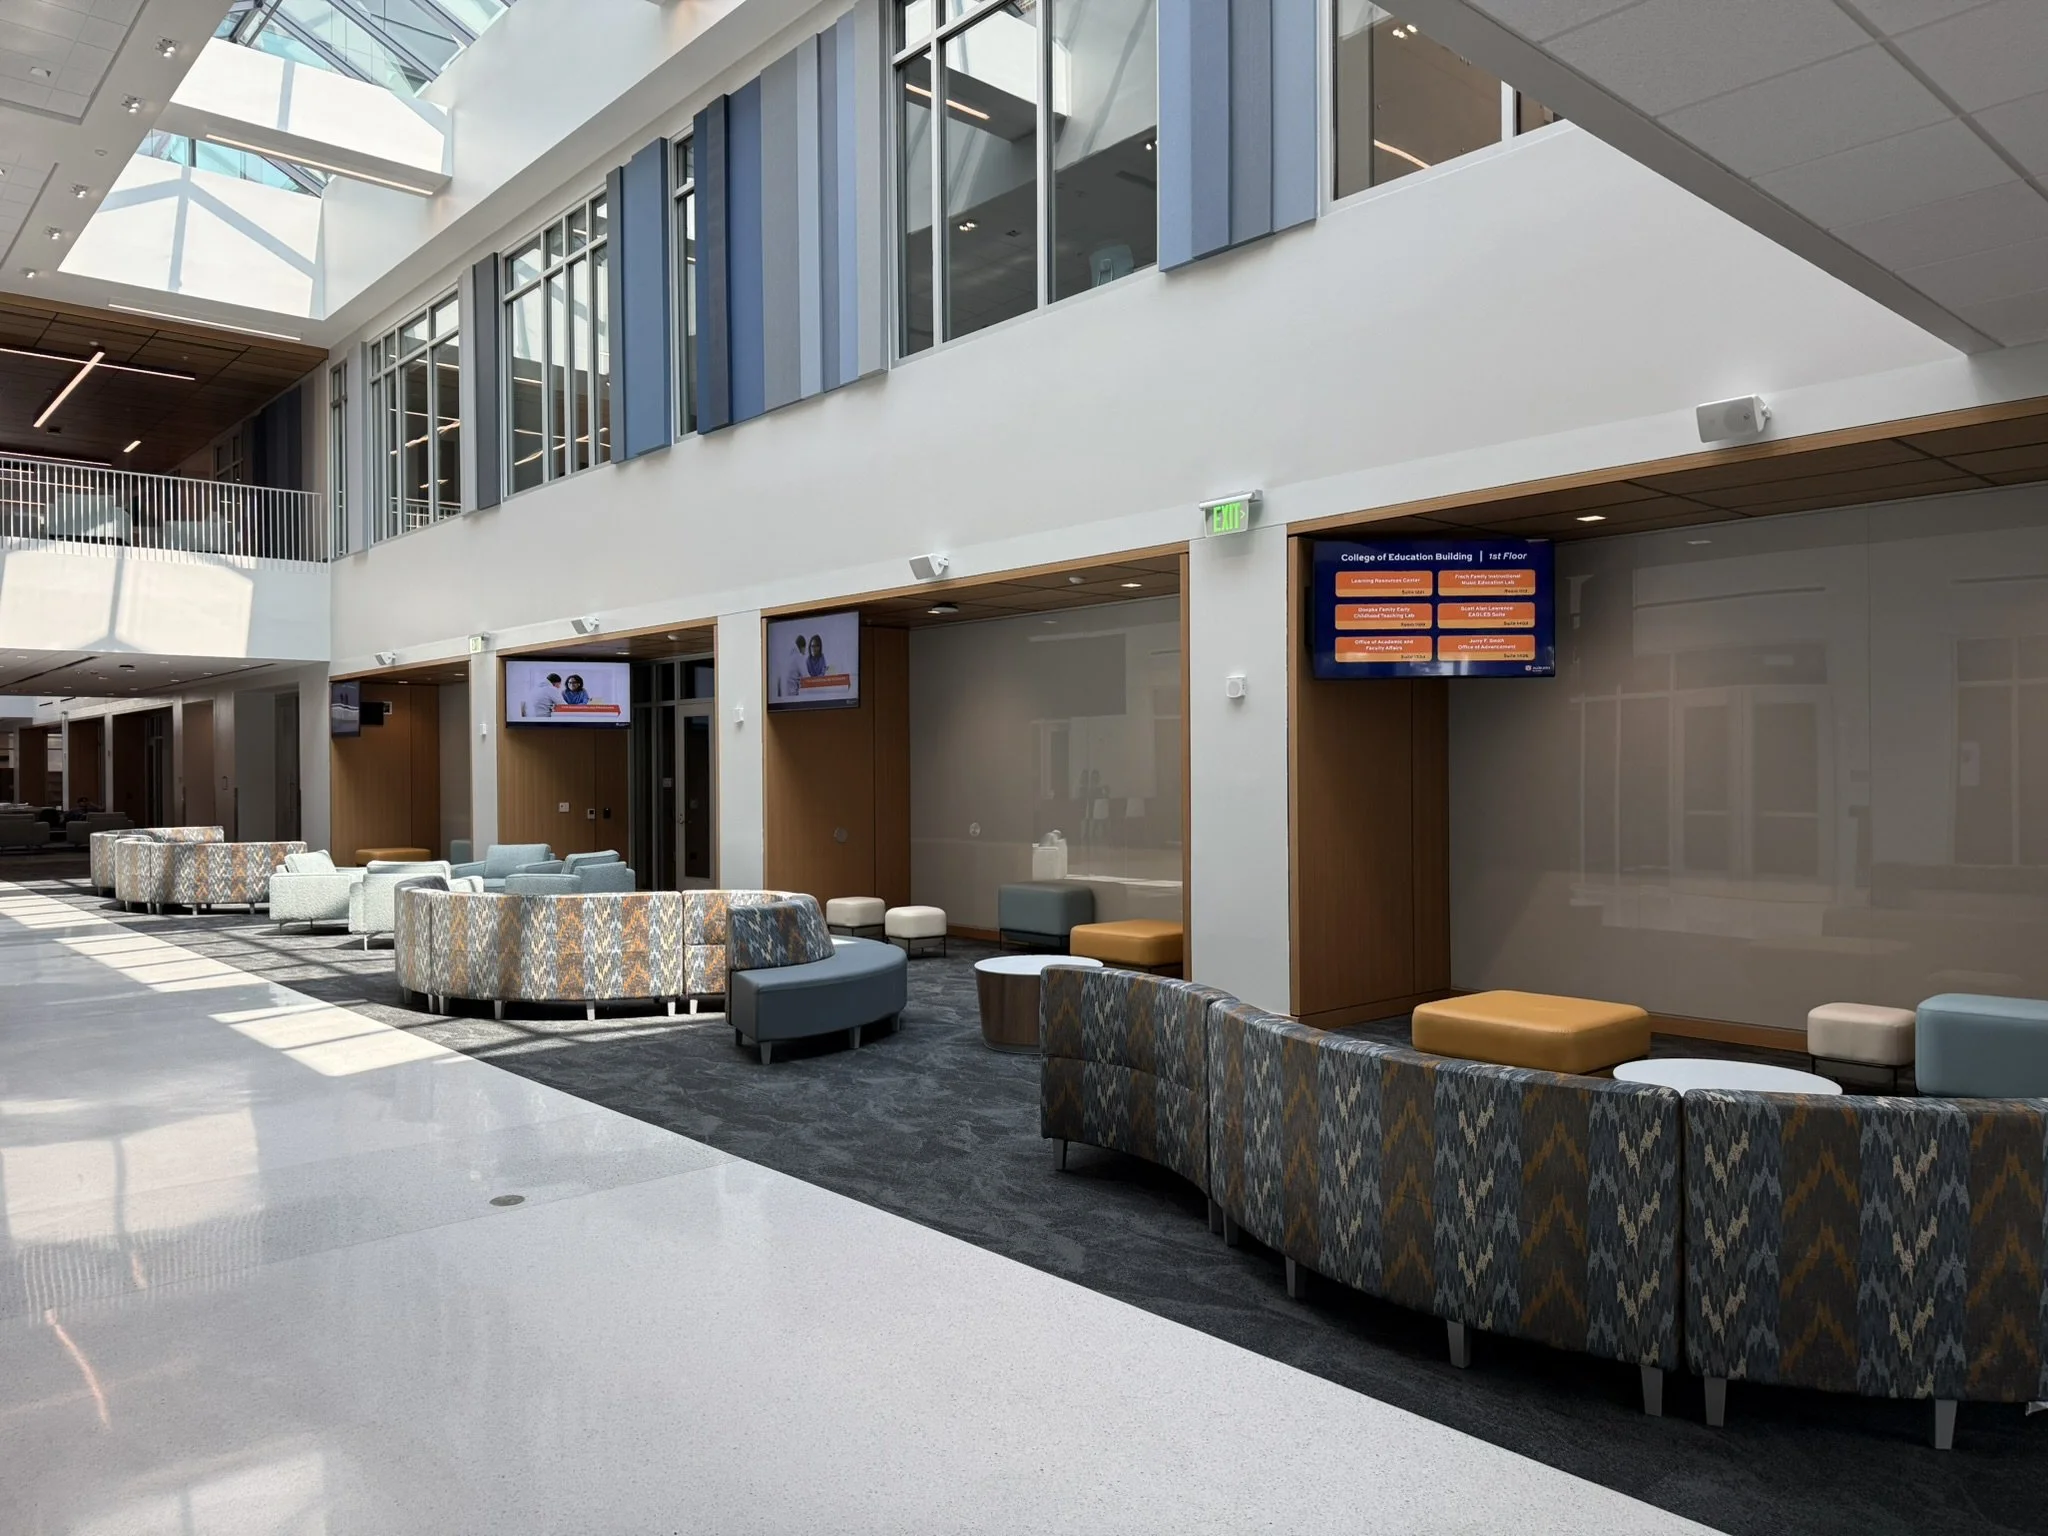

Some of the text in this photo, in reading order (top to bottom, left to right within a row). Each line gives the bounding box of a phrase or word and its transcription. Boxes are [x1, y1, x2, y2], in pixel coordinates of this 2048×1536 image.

[1213, 502, 1241, 533] EXIT
[1341, 552, 1473, 563] College of Education Building
[1503, 552, 1528, 560] Floor
